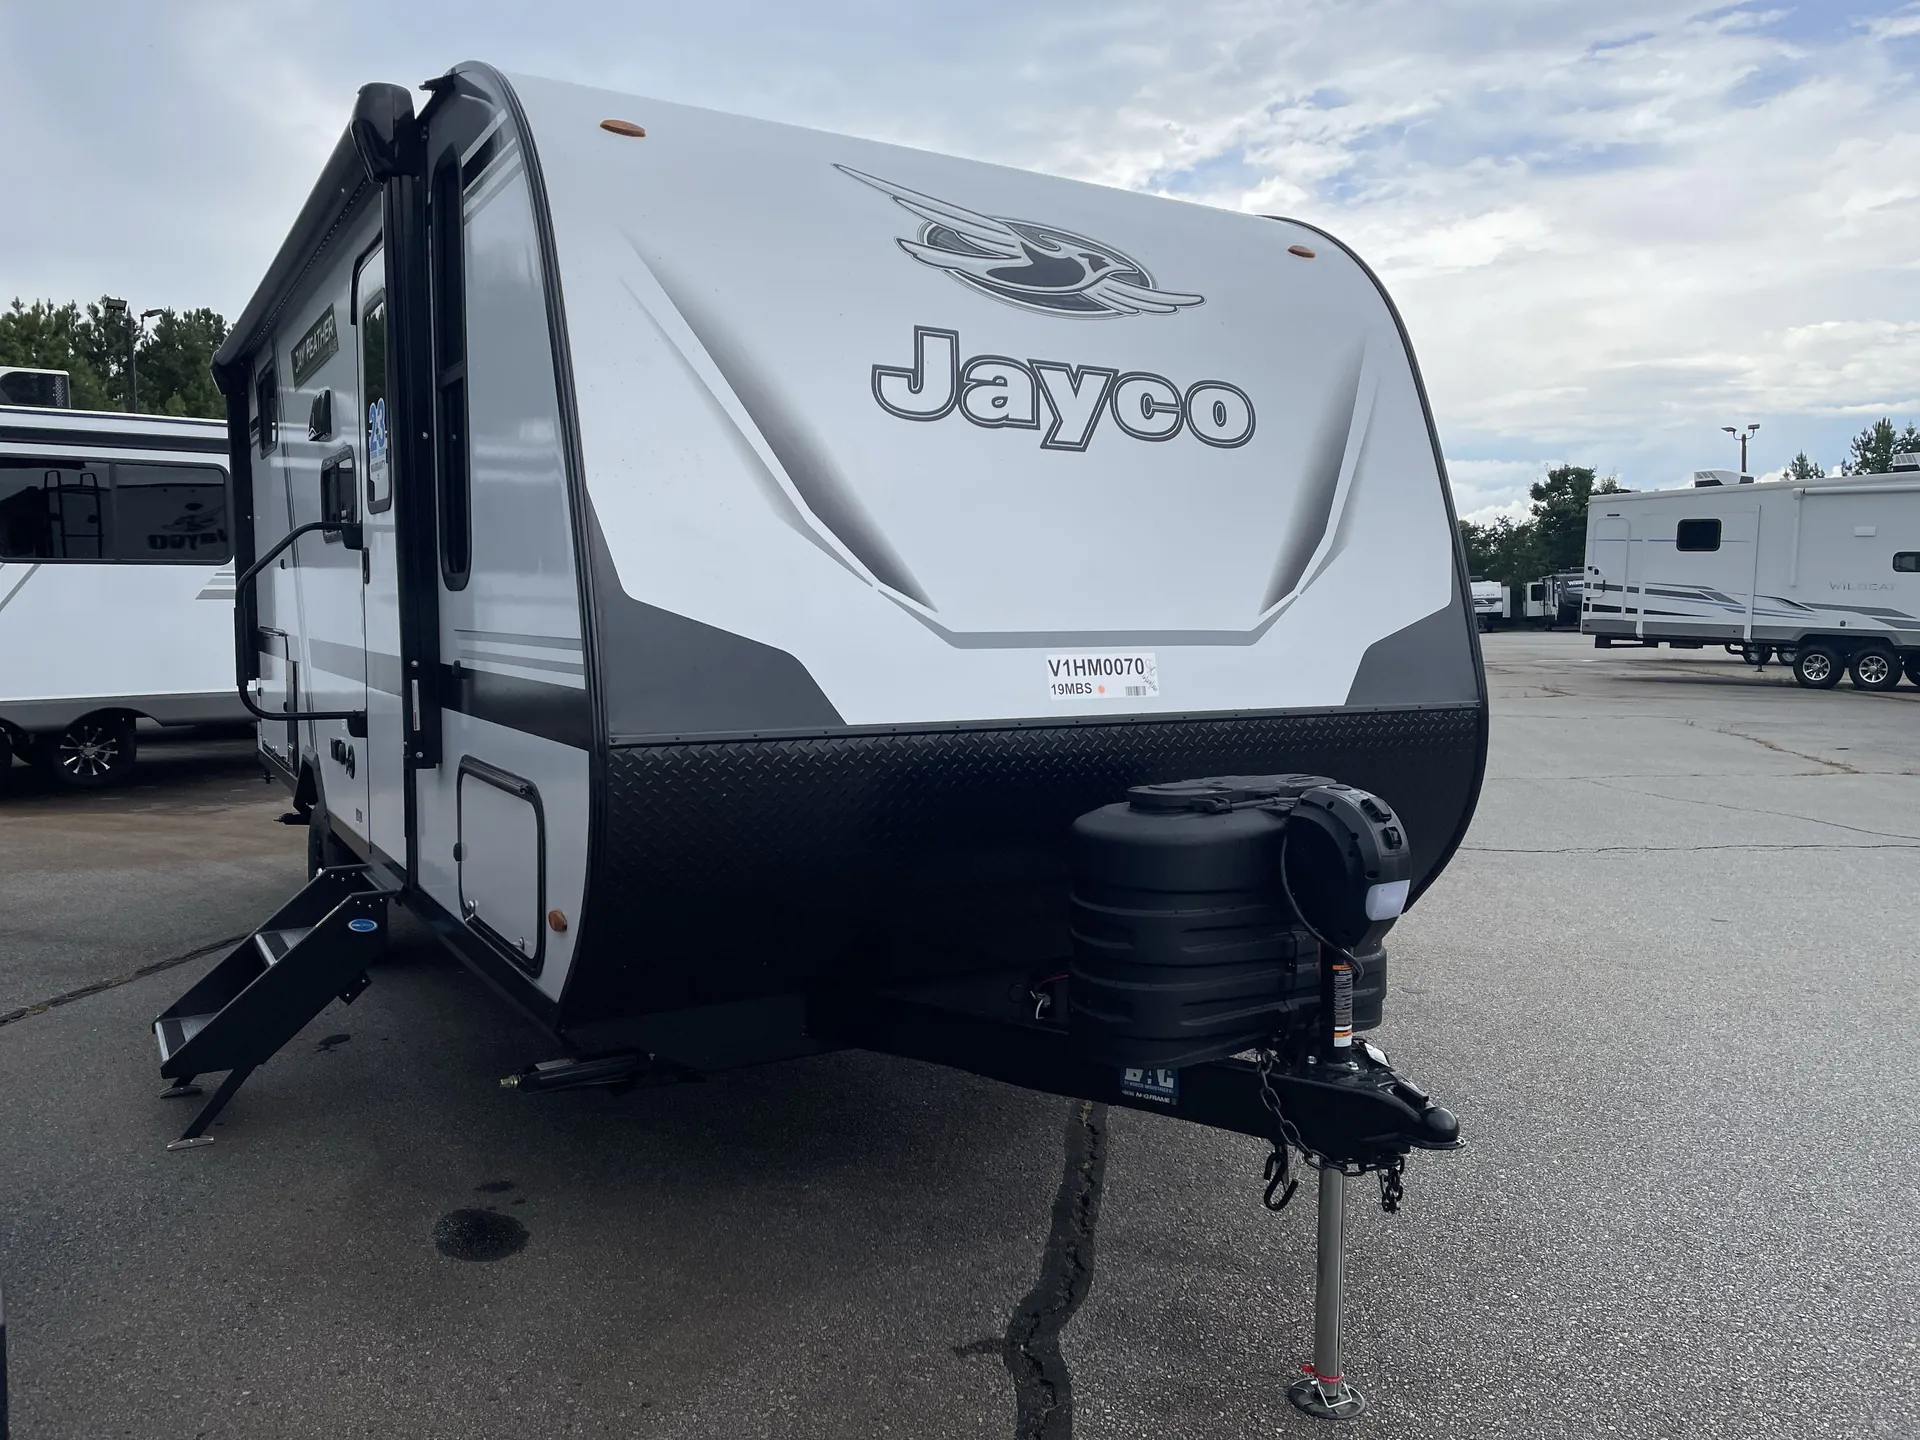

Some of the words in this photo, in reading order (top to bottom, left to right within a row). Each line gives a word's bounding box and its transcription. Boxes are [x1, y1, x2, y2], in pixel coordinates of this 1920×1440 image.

[306, 314, 334, 362] FEATHER
[872, 325, 1256, 452] Jayco
[1829, 581, 1895, 591] WILDCAT
[1047, 657, 1145, 677] V1HM0070
[1050, 682, 1093, 695] 19MBS
